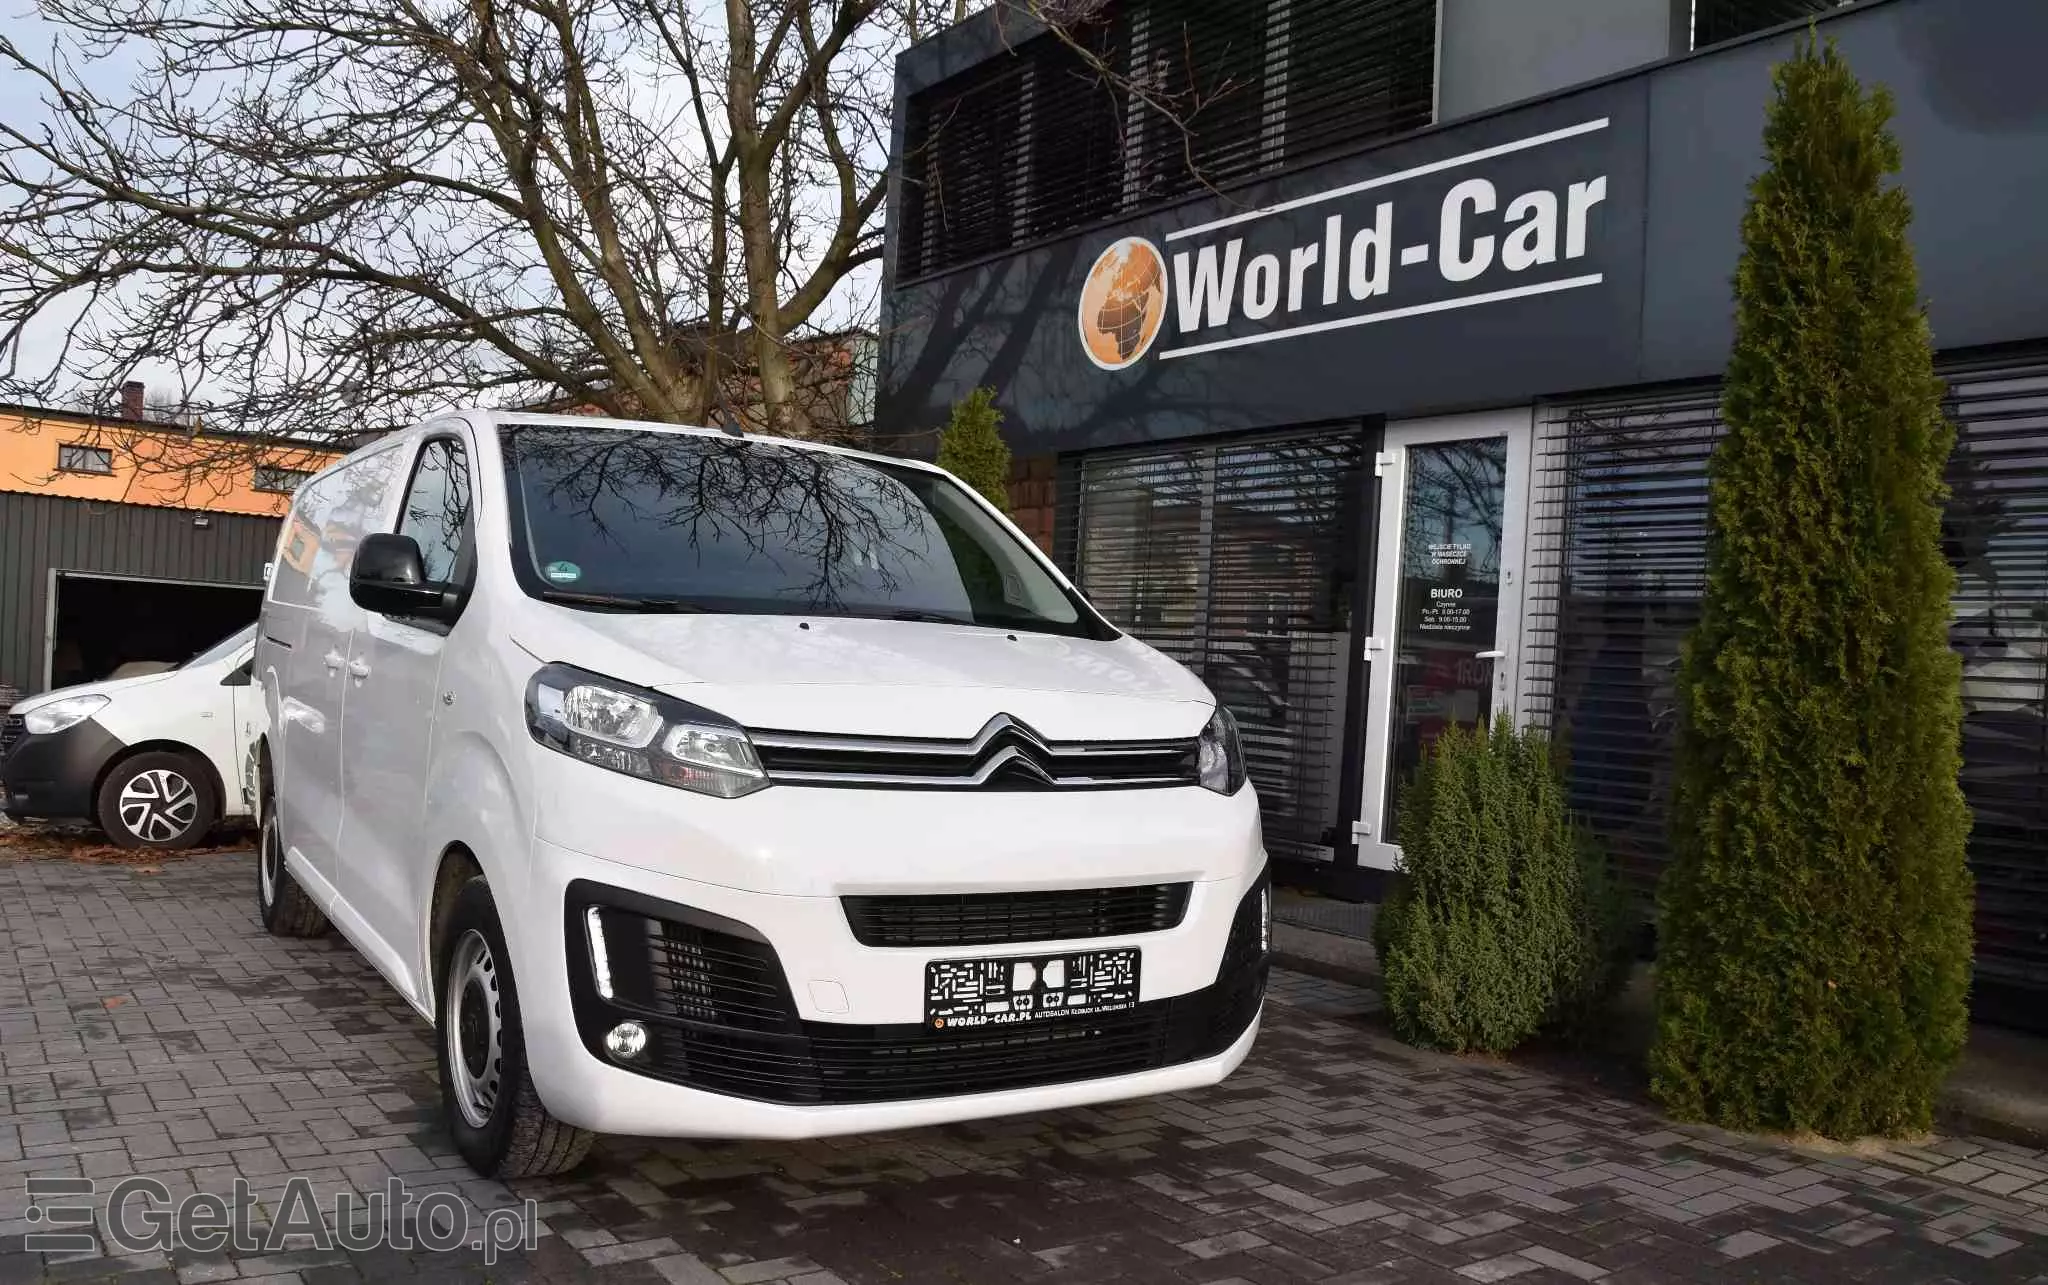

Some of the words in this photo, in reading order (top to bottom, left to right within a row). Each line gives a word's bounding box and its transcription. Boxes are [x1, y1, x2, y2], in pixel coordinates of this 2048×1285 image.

[1174, 175, 1607, 333] World-Car
[1430, 588, 1463, 599] BIURO
[947, 1012, 1032, 1027] WORLD-CAR.PL
[1034, 1009, 1070, 1018] AUTOSALON
